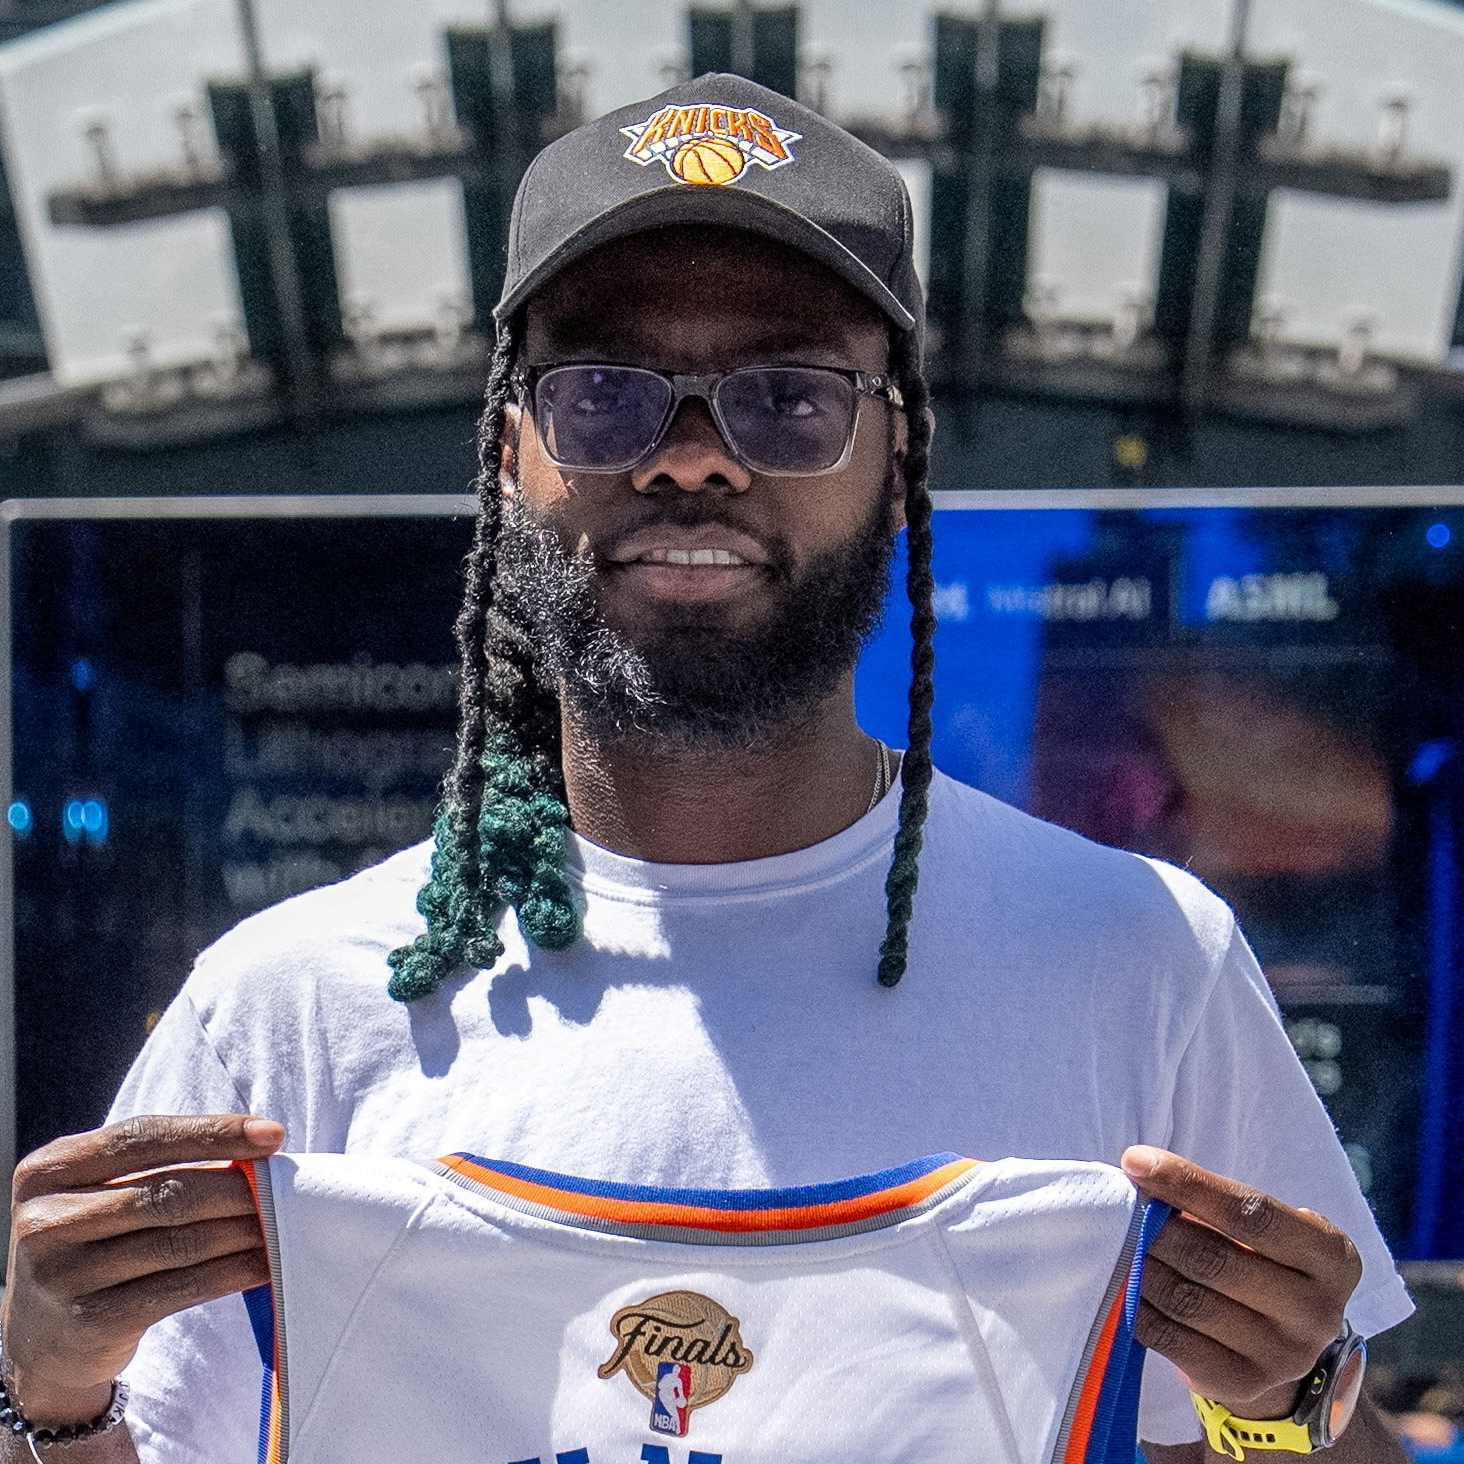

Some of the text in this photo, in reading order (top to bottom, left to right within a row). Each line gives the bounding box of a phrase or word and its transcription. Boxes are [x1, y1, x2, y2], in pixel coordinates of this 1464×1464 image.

[632, 106, 789, 159] KNICKS
[604, 1313, 747, 1374] Finals
[654, 1414, 675, 1431] NBA
